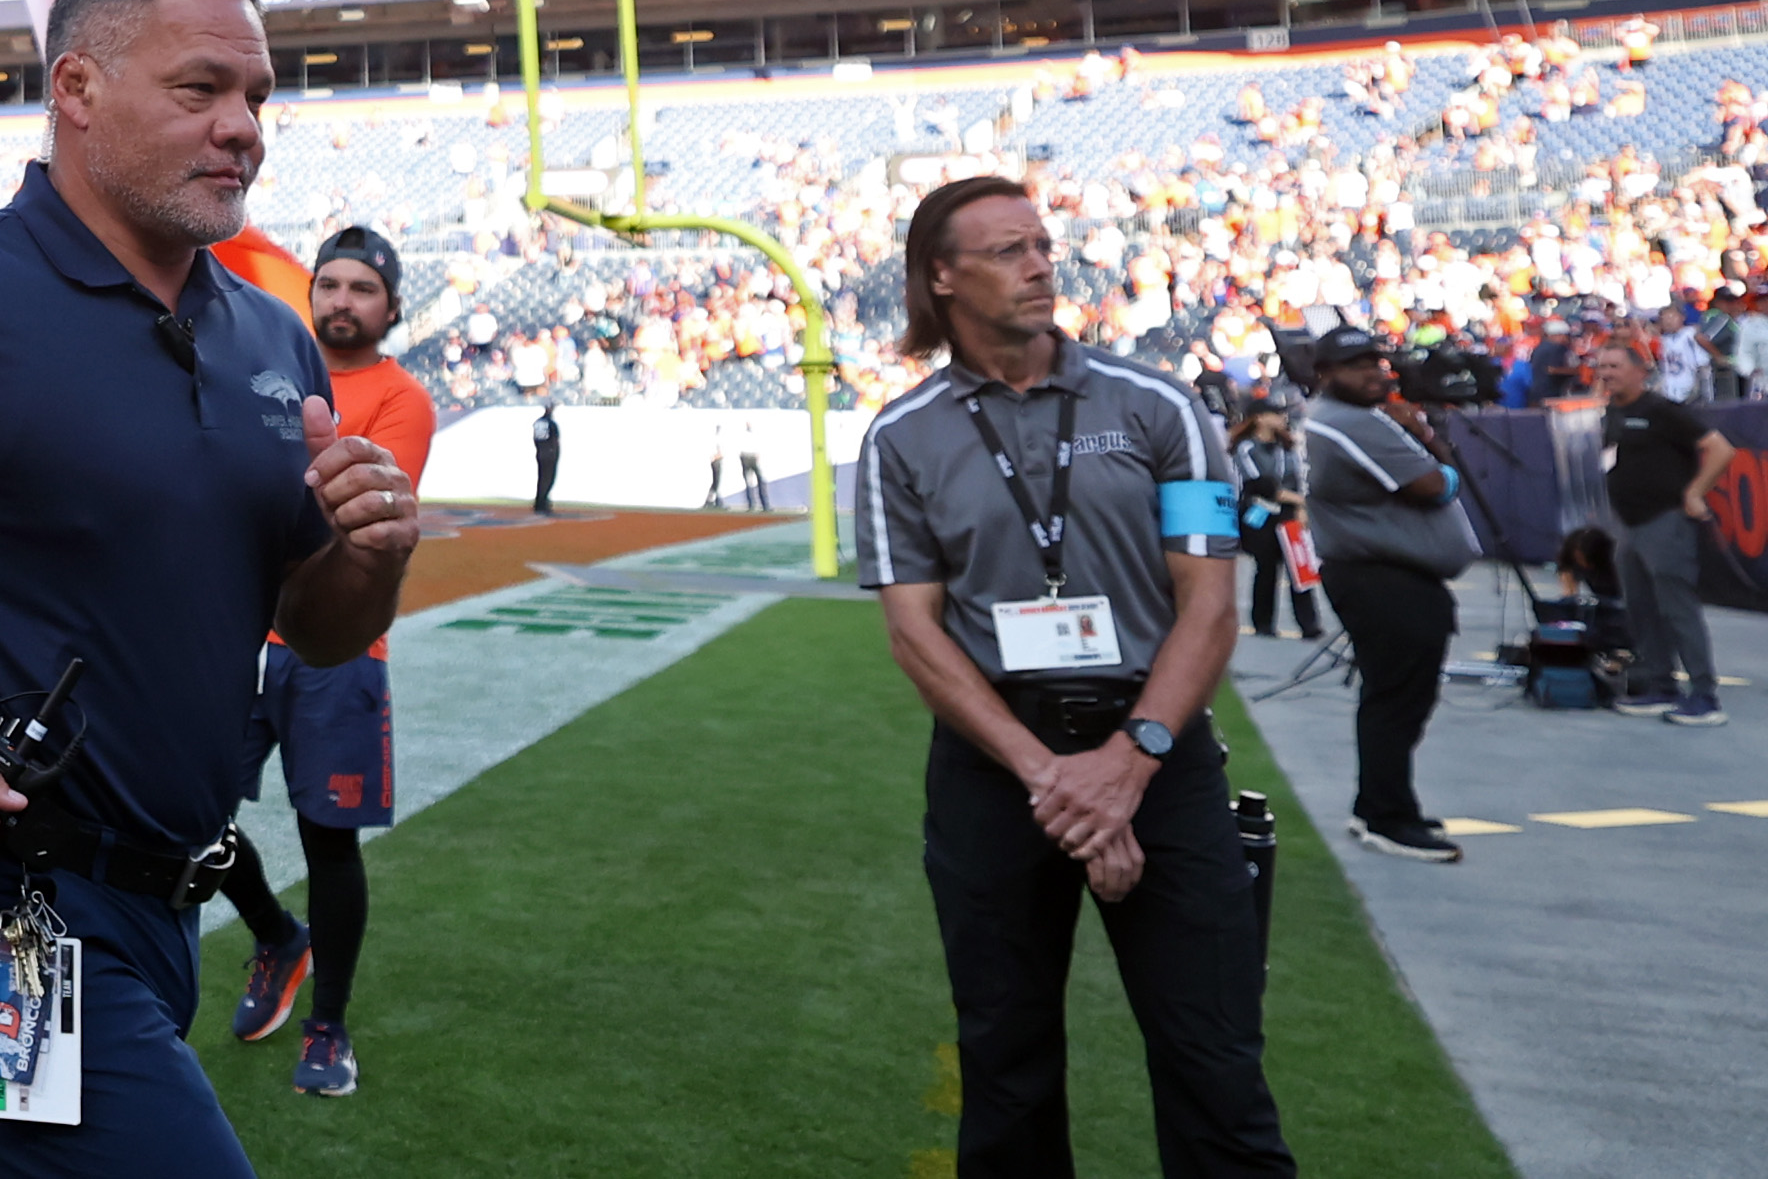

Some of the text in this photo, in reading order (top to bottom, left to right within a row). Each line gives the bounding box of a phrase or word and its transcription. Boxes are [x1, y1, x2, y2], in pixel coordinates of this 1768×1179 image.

[1073, 431, 1133, 456] argus
[61, 979, 73, 998] TEAM
[15, 993, 43, 1073] BRONCO
